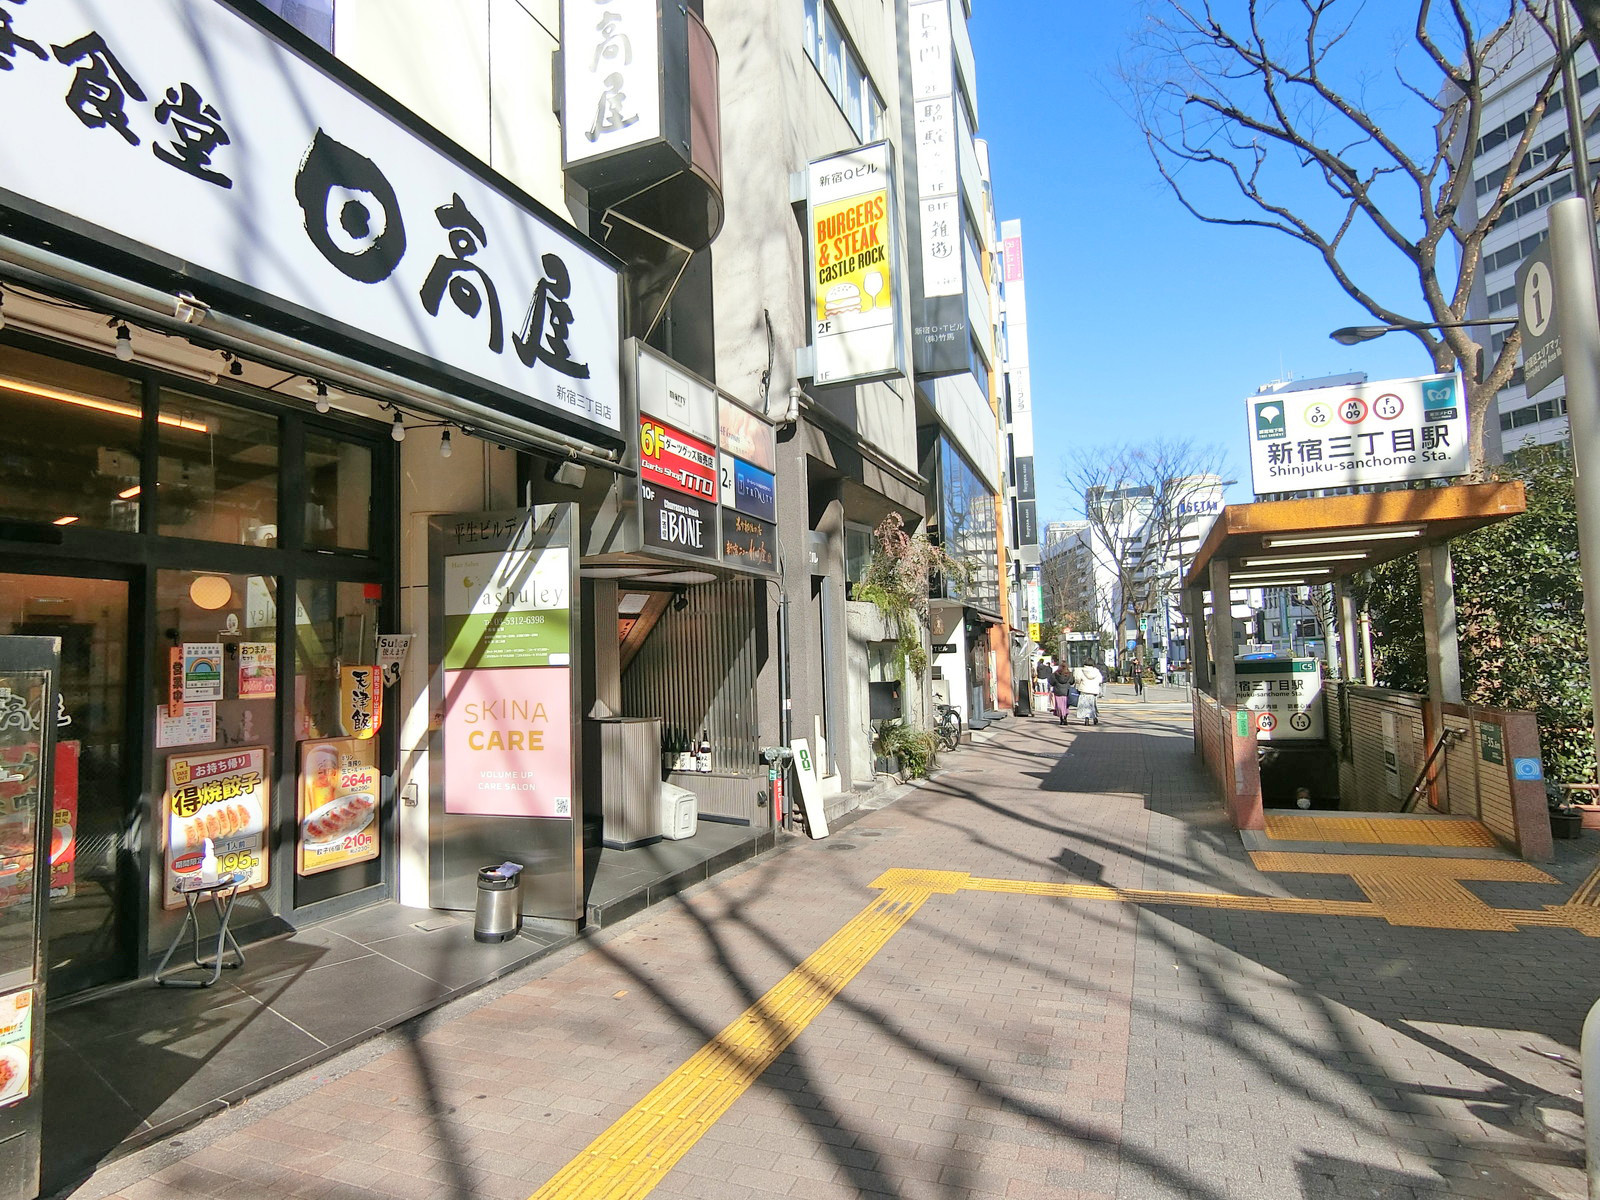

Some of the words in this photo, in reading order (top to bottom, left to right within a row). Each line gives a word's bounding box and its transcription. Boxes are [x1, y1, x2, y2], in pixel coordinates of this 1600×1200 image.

[585, 0, 640, 143] 高屋
[819, 163, 878, 187] 新宿Qビル
[931, 183, 944, 192] 1F
[928, 202, 949, 212] B1F
[816, 196, 884, 244] BURGERS
[819, 243, 830, 268] &
[834, 222, 879, 262] STEAK
[858, 245, 885, 269] ROCK
[818, 321, 831, 334] 2F
[1524, 335, 1561, 371] 新宿区エリアマッ
[819, 371, 831, 381] 1F
[556, 384, 612, 420] 新宿三丁目店
[1315, 406, 1321, 414] S
[1347, 403, 1358, 411] M
[1385, 398, 1391, 406] F
[1311, 414, 1326, 423] 02
[1345, 410, 1361, 420] 09
[1382, 406, 1396, 415] 13
[640, 421, 665, 460] 6F
[1267, 424, 1451, 466] 新宿三丁目駅
[665, 438, 714, 469] ダーツグッズ販売店
[1269, 455, 1416, 478] Shinjuku-sanchome
[1421, 449, 1452, 463] Sta.
[721, 467, 732, 489] 2F
[641, 485, 655, 500] 10F
[745, 486, 773, 503] TRINITY
[1179, 500, 1218, 513] ISETAN
[455, 513, 558, 545] 平生ビルディング
[668, 511, 704, 549] BONE
[241, 645, 268, 654] おつまみ
[382, 648, 406, 656] 使えます
[1301, 663, 1313, 671] C5
[1235, 679, 1304, 692] 宿三丁目駅
[351, 670, 371, 731] 天津飯
[1236, 691, 1290, 699] njuku-sanchome
[464, 698, 549, 724] SKINA
[468, 730, 545, 751] CARE
[195, 755, 246, 777] お持ち帰り
[341, 773, 372, 788] 264円
[480, 771, 518, 779] VOLUME
[521, 771, 534, 779] UP
[173, 786, 200, 816] 得
[202, 771, 261, 805] 焼餃子
[478, 782, 502, 791] CARE
[504, 782, 536, 791] SALON
[226, 840, 246, 851] 1人前
[343, 833, 372, 849] 210円
[217, 849, 259, 874] 195円
